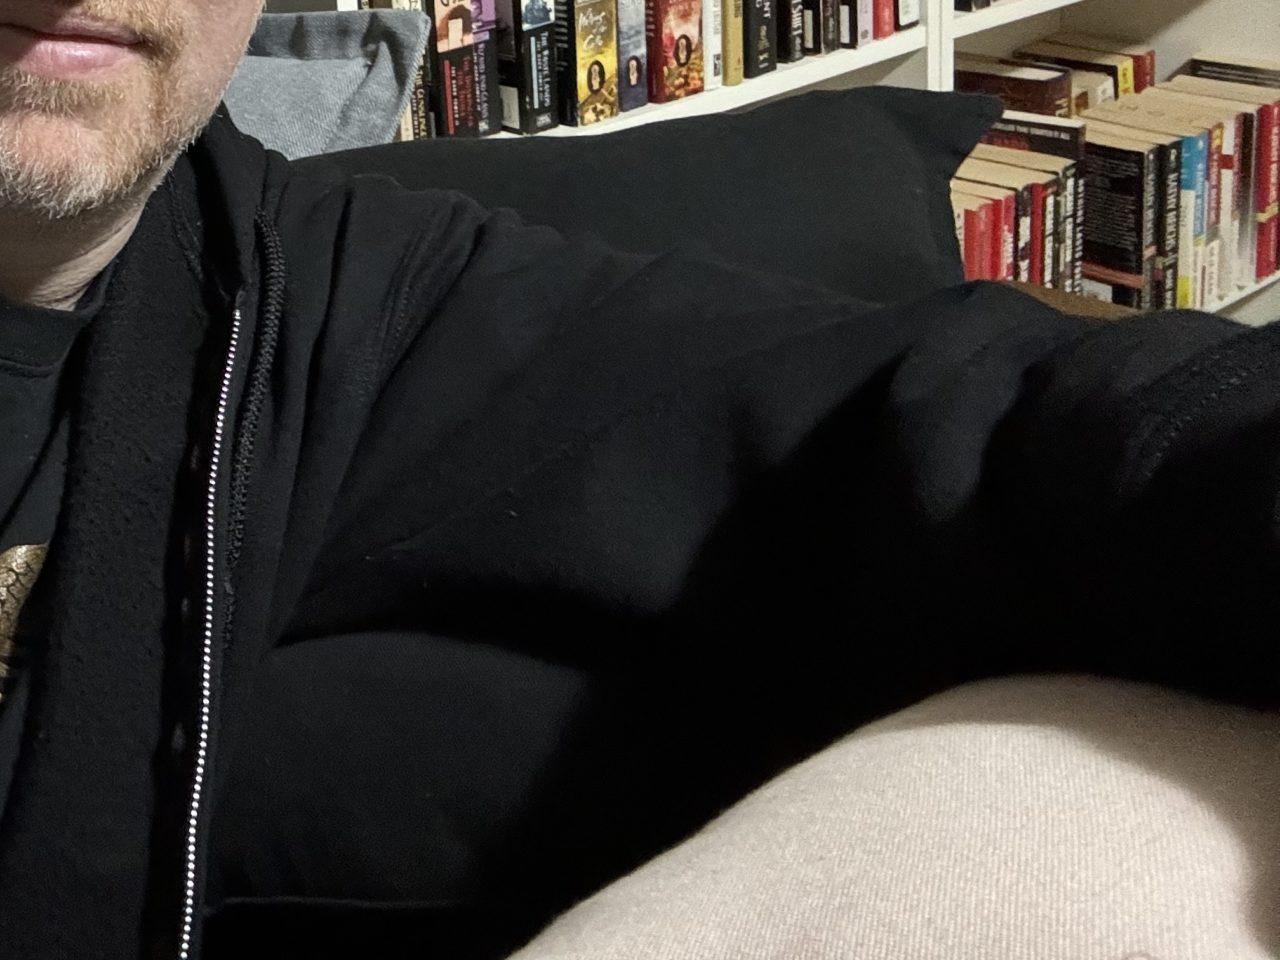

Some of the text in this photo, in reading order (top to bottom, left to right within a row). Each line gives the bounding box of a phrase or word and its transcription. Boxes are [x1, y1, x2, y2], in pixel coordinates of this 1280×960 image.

[792, 3, 803, 36] SHIFT
[540, 31, 552, 107] THE WASTE LANDS
